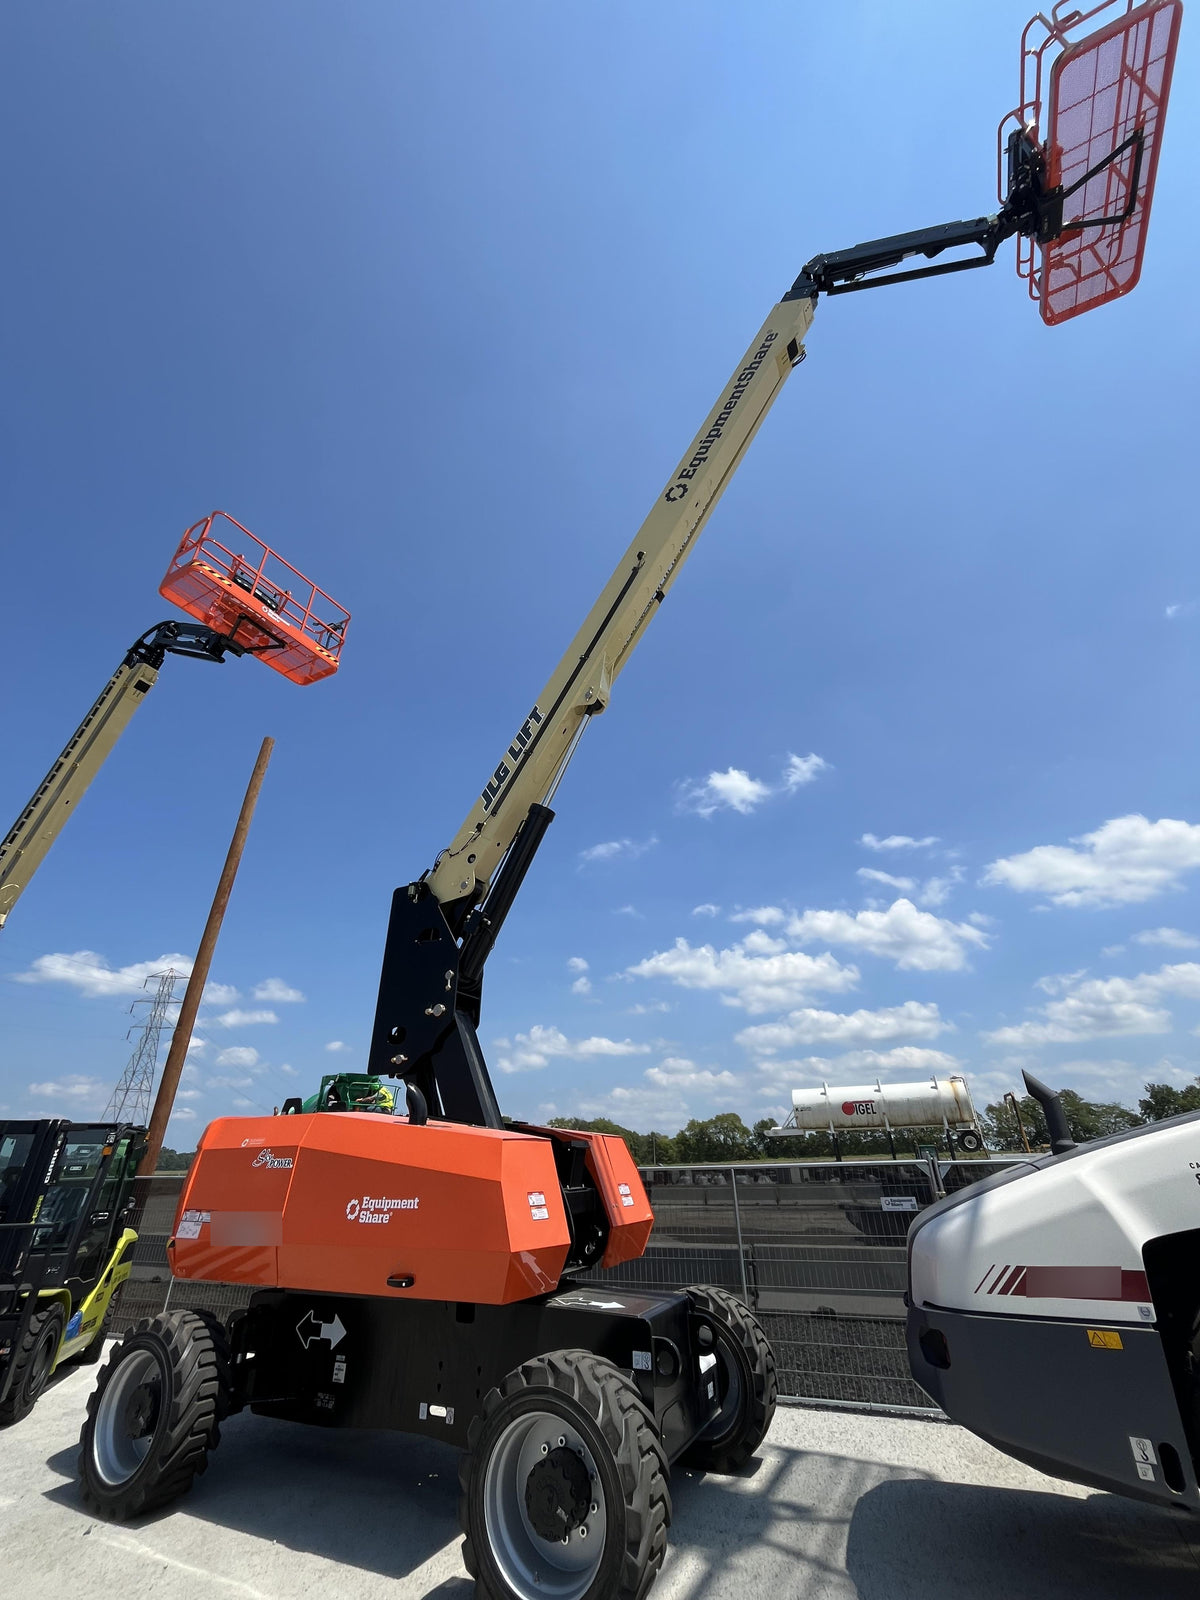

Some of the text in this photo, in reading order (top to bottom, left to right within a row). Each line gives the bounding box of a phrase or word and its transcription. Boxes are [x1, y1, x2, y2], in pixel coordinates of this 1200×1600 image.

[480, 704, 545, 813] JLG LIFT
[855, 1103, 877, 1115] IGEL
[266, 1158, 293, 1168] POWER
[362, 1196, 420, 1211] Equipment
